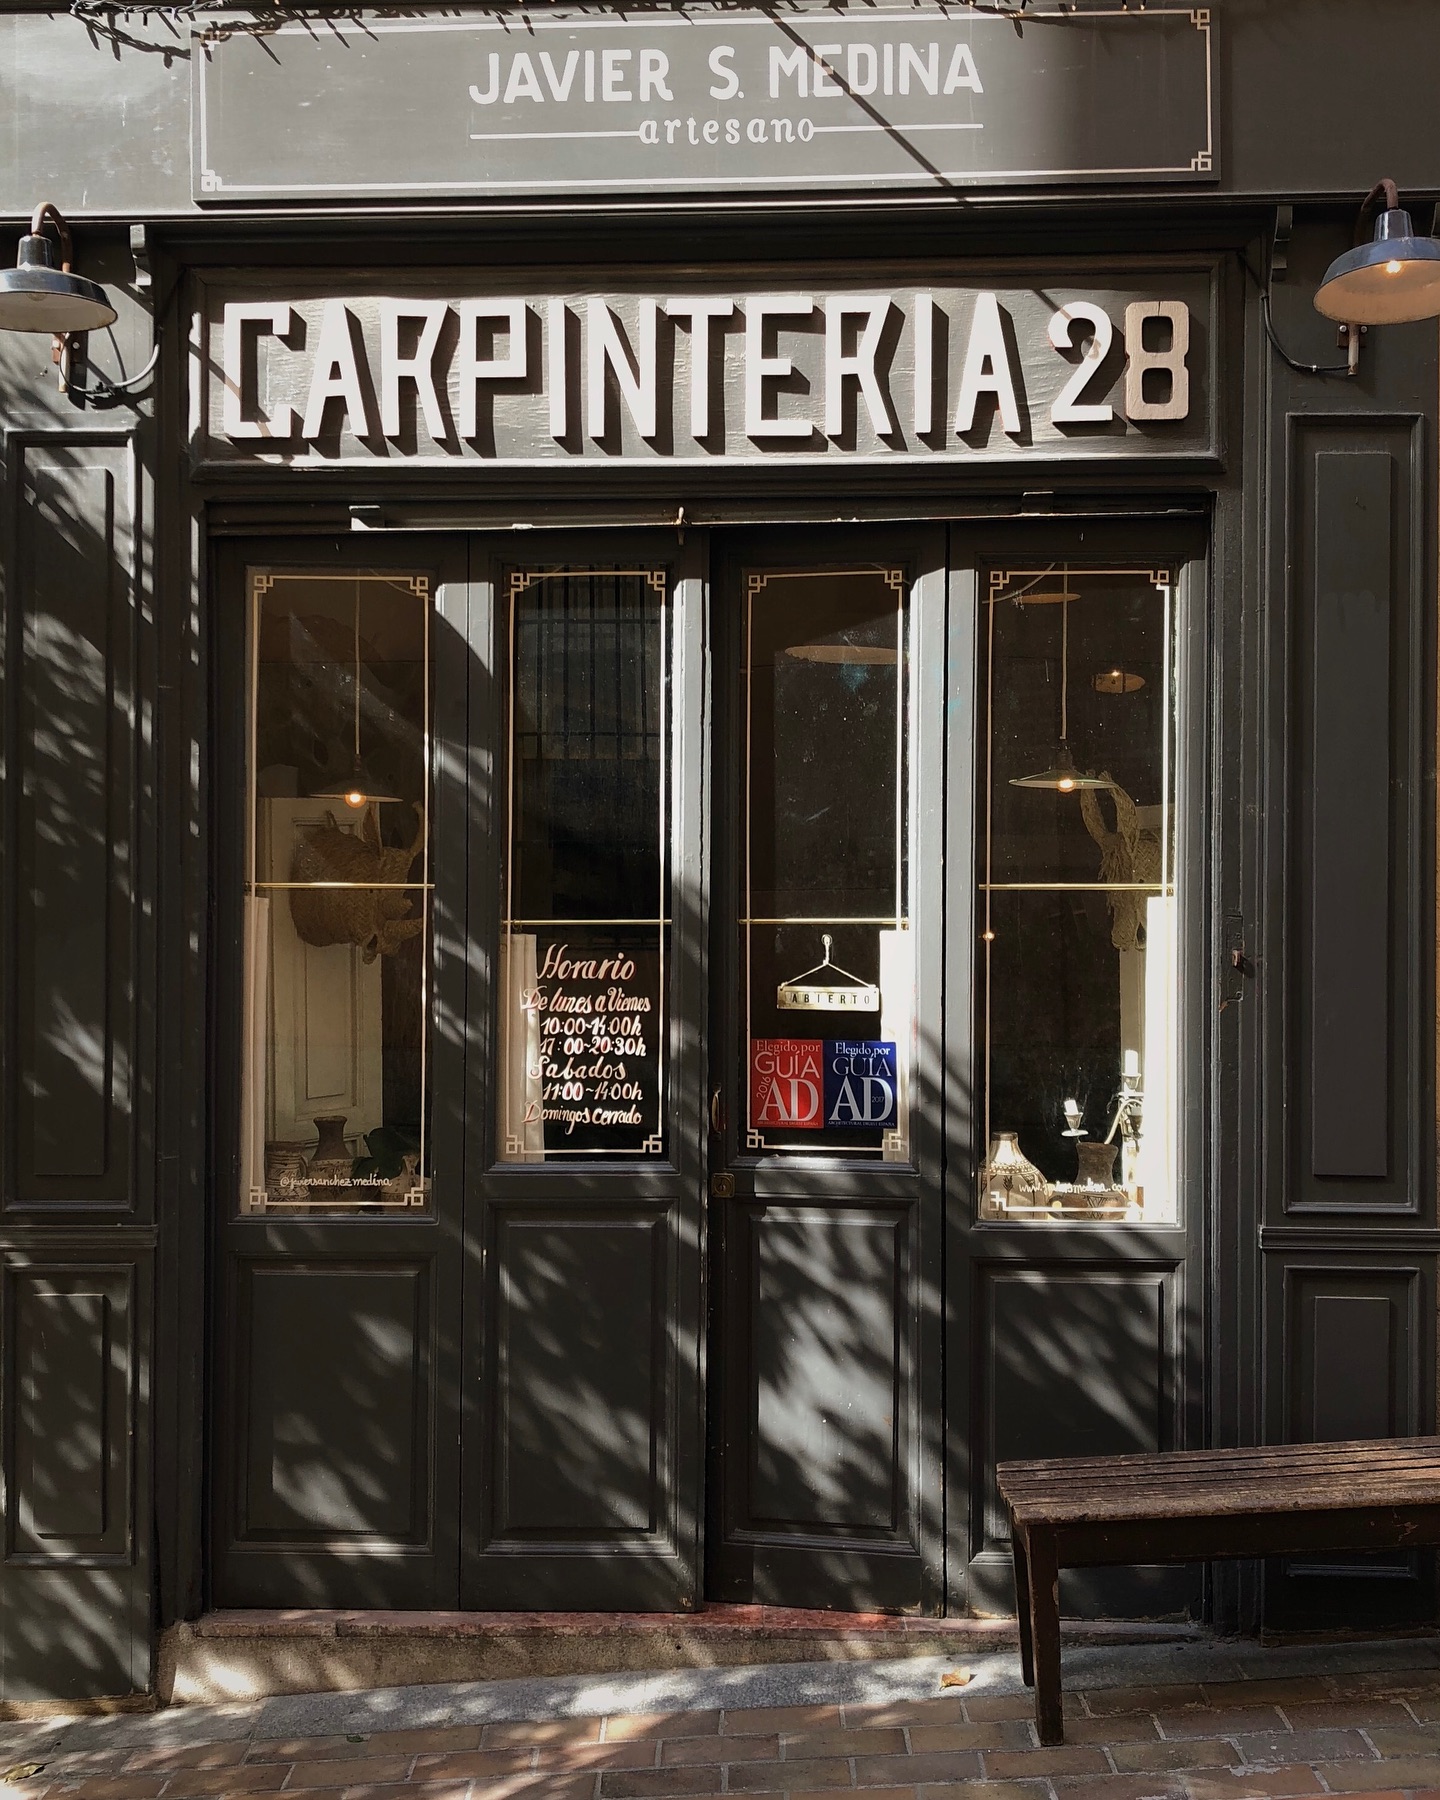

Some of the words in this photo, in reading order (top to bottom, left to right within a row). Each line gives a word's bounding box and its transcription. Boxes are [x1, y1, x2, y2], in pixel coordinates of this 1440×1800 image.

[469, 48, 674, 104] JAVIER
[708, 44, 746, 100] S.
[769, 43, 985, 98] MEDINA
[638, 116, 815, 145] artesano
[222, 293, 1020, 439] CARPINTERIA
[1048, 300, 1190, 421] 28
[535, 943, 636, 981] Horario
[521, 985, 548, 1012] De
[549, 986, 592, 1014] lunes
[594, 996, 608, 1014] a
[791, 993, 870, 1005] ABIERTO
[756, 1040, 798, 1056] Elegido
[801, 1042, 821, 1057] por
[835, 1042, 872, 1058] Elegido
[873, 1046, 890, 1058] por
[528, 1055, 627, 1081] Sabados
[754, 1050, 821, 1079] GUÍA
[832, 1054, 892, 1077] GUÍA
[756, 1076, 772, 1100] 2016
[757, 1077, 819, 1121] AD
[828, 1075, 893, 1122] AD
[521, 1100, 590, 1135] Domingos
